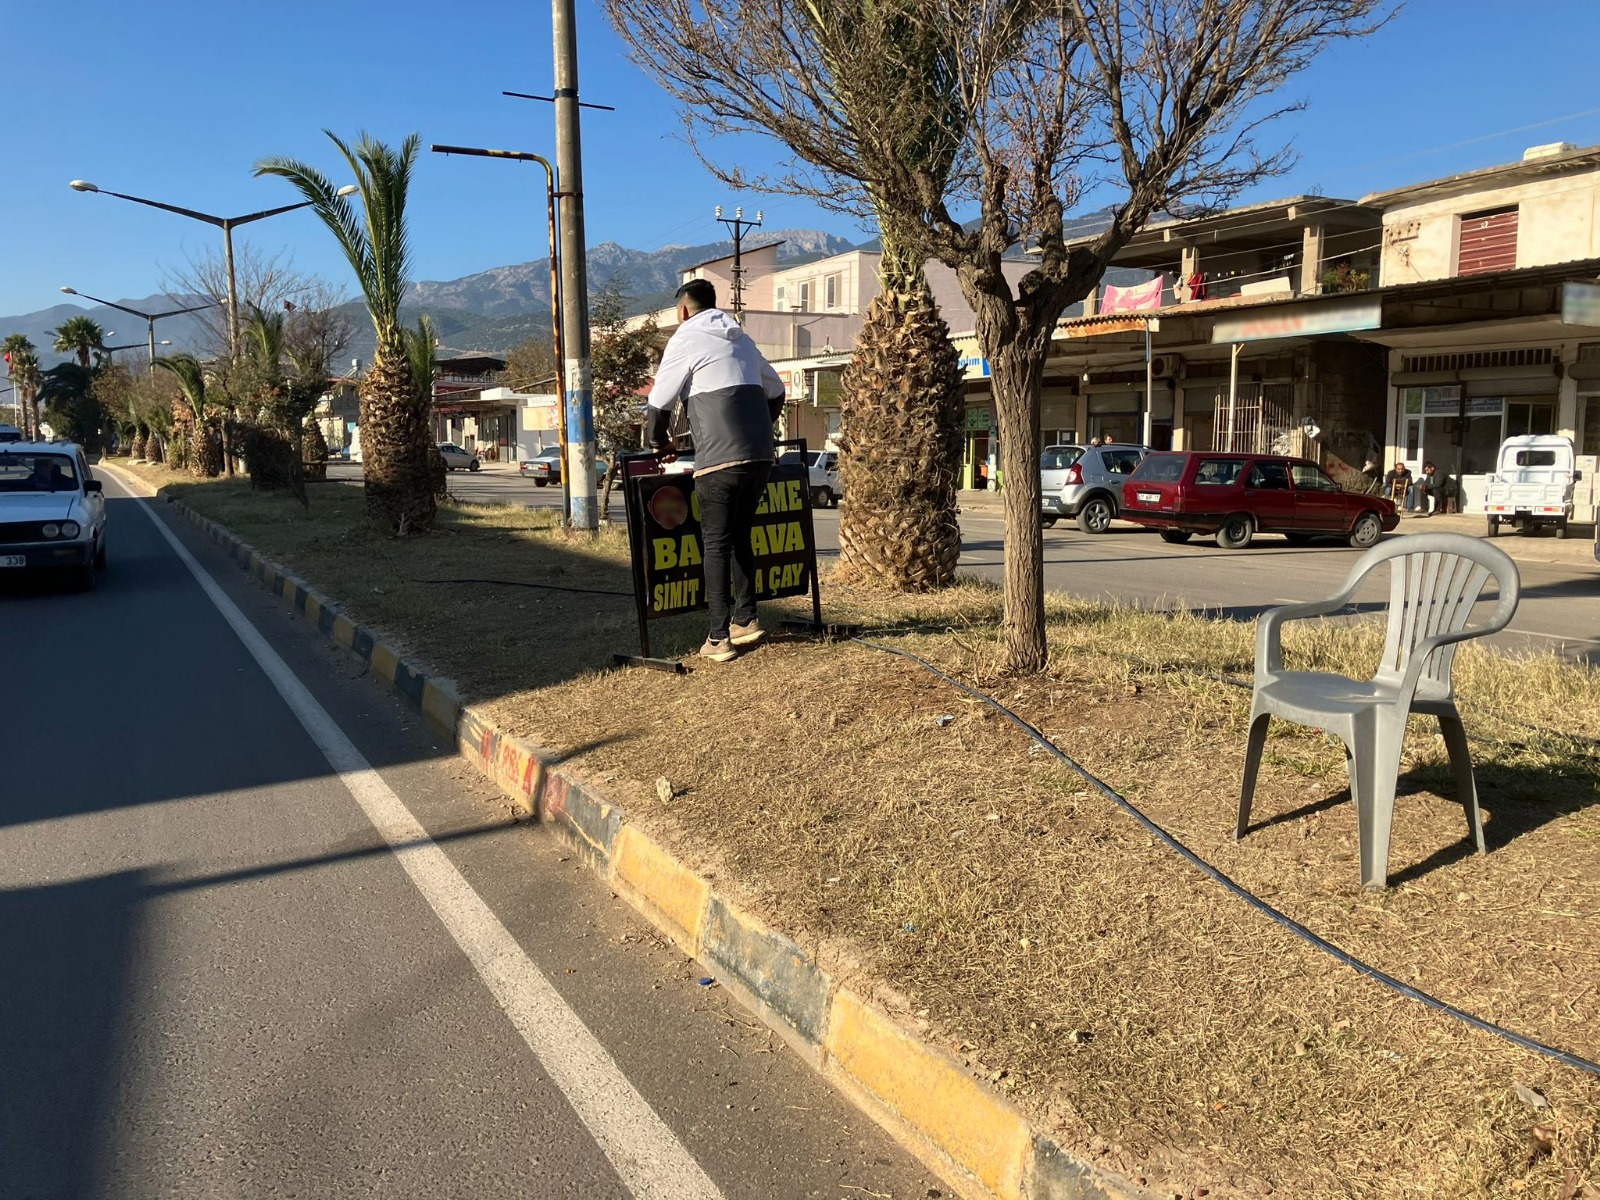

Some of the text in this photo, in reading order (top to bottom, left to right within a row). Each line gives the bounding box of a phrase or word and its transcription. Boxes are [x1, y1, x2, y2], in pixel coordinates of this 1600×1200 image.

[652, 521, 805, 570] BAAVA
[653, 572, 699, 612] SİMİT
[768, 563, 804, 596] ÇAY
